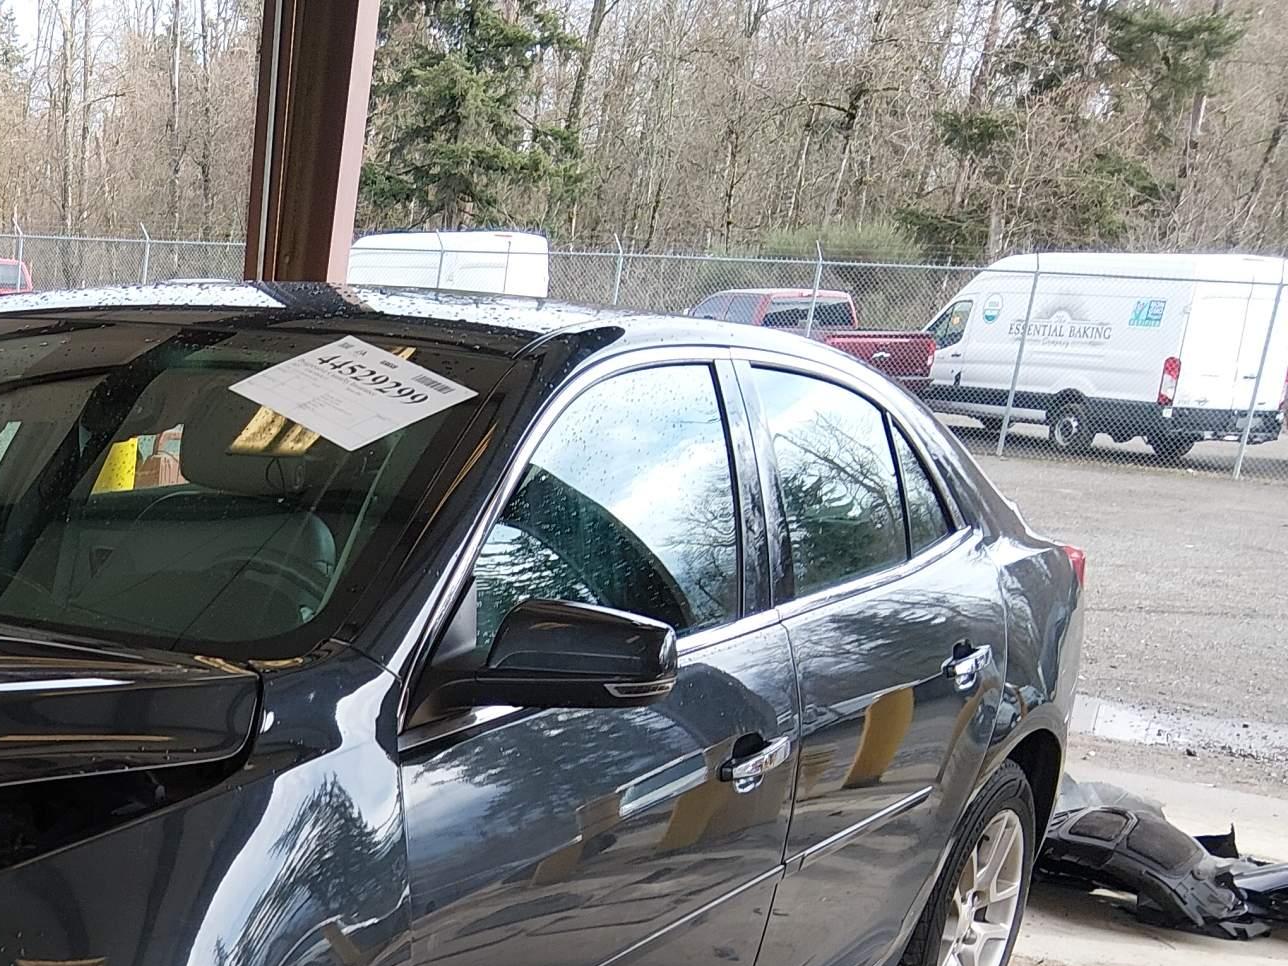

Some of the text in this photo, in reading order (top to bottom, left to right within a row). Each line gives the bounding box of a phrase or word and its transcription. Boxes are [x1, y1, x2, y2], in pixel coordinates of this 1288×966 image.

[1008, 323, 1113, 340] ESSENTIAL BAKING
[317, 355, 429, 404] 44529299
